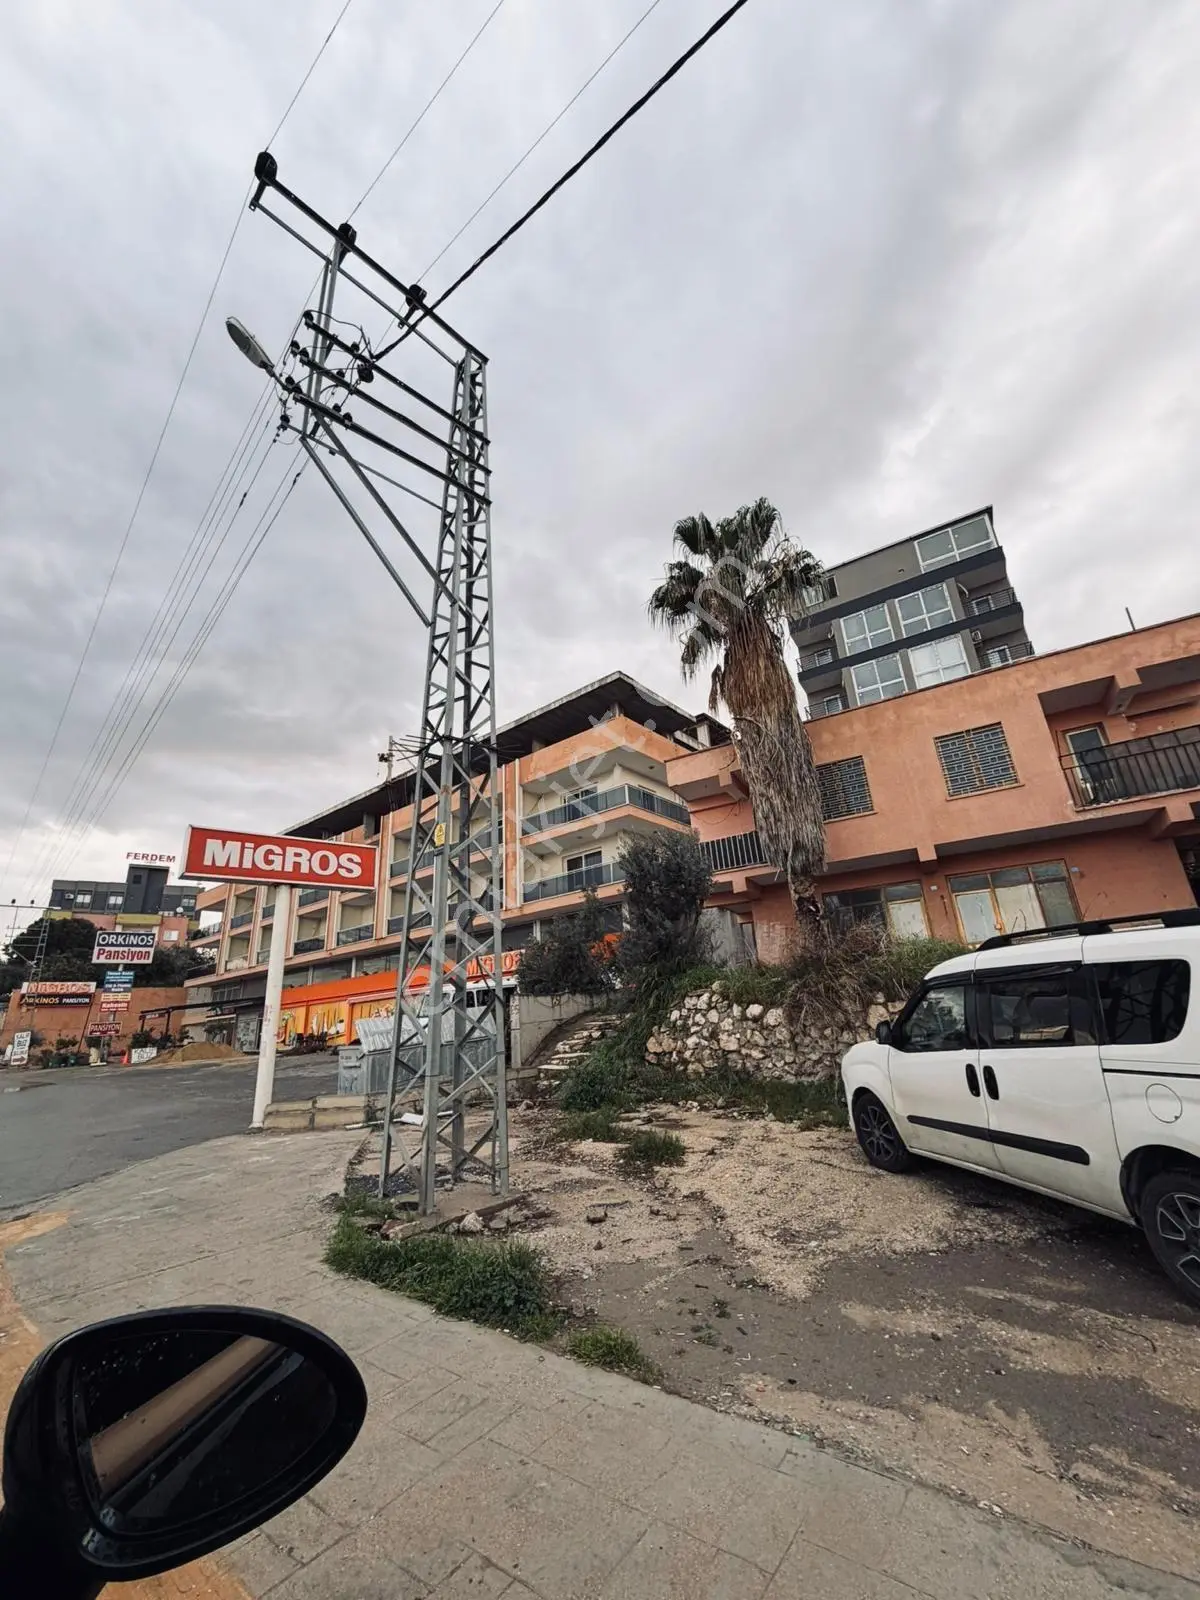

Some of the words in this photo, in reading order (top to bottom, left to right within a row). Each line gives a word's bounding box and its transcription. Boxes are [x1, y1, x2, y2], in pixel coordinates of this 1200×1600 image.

[126, 851, 176, 863] FERDEM
[203, 838, 362, 878] MiGROS
[96, 948, 151, 961] Pansiyon
